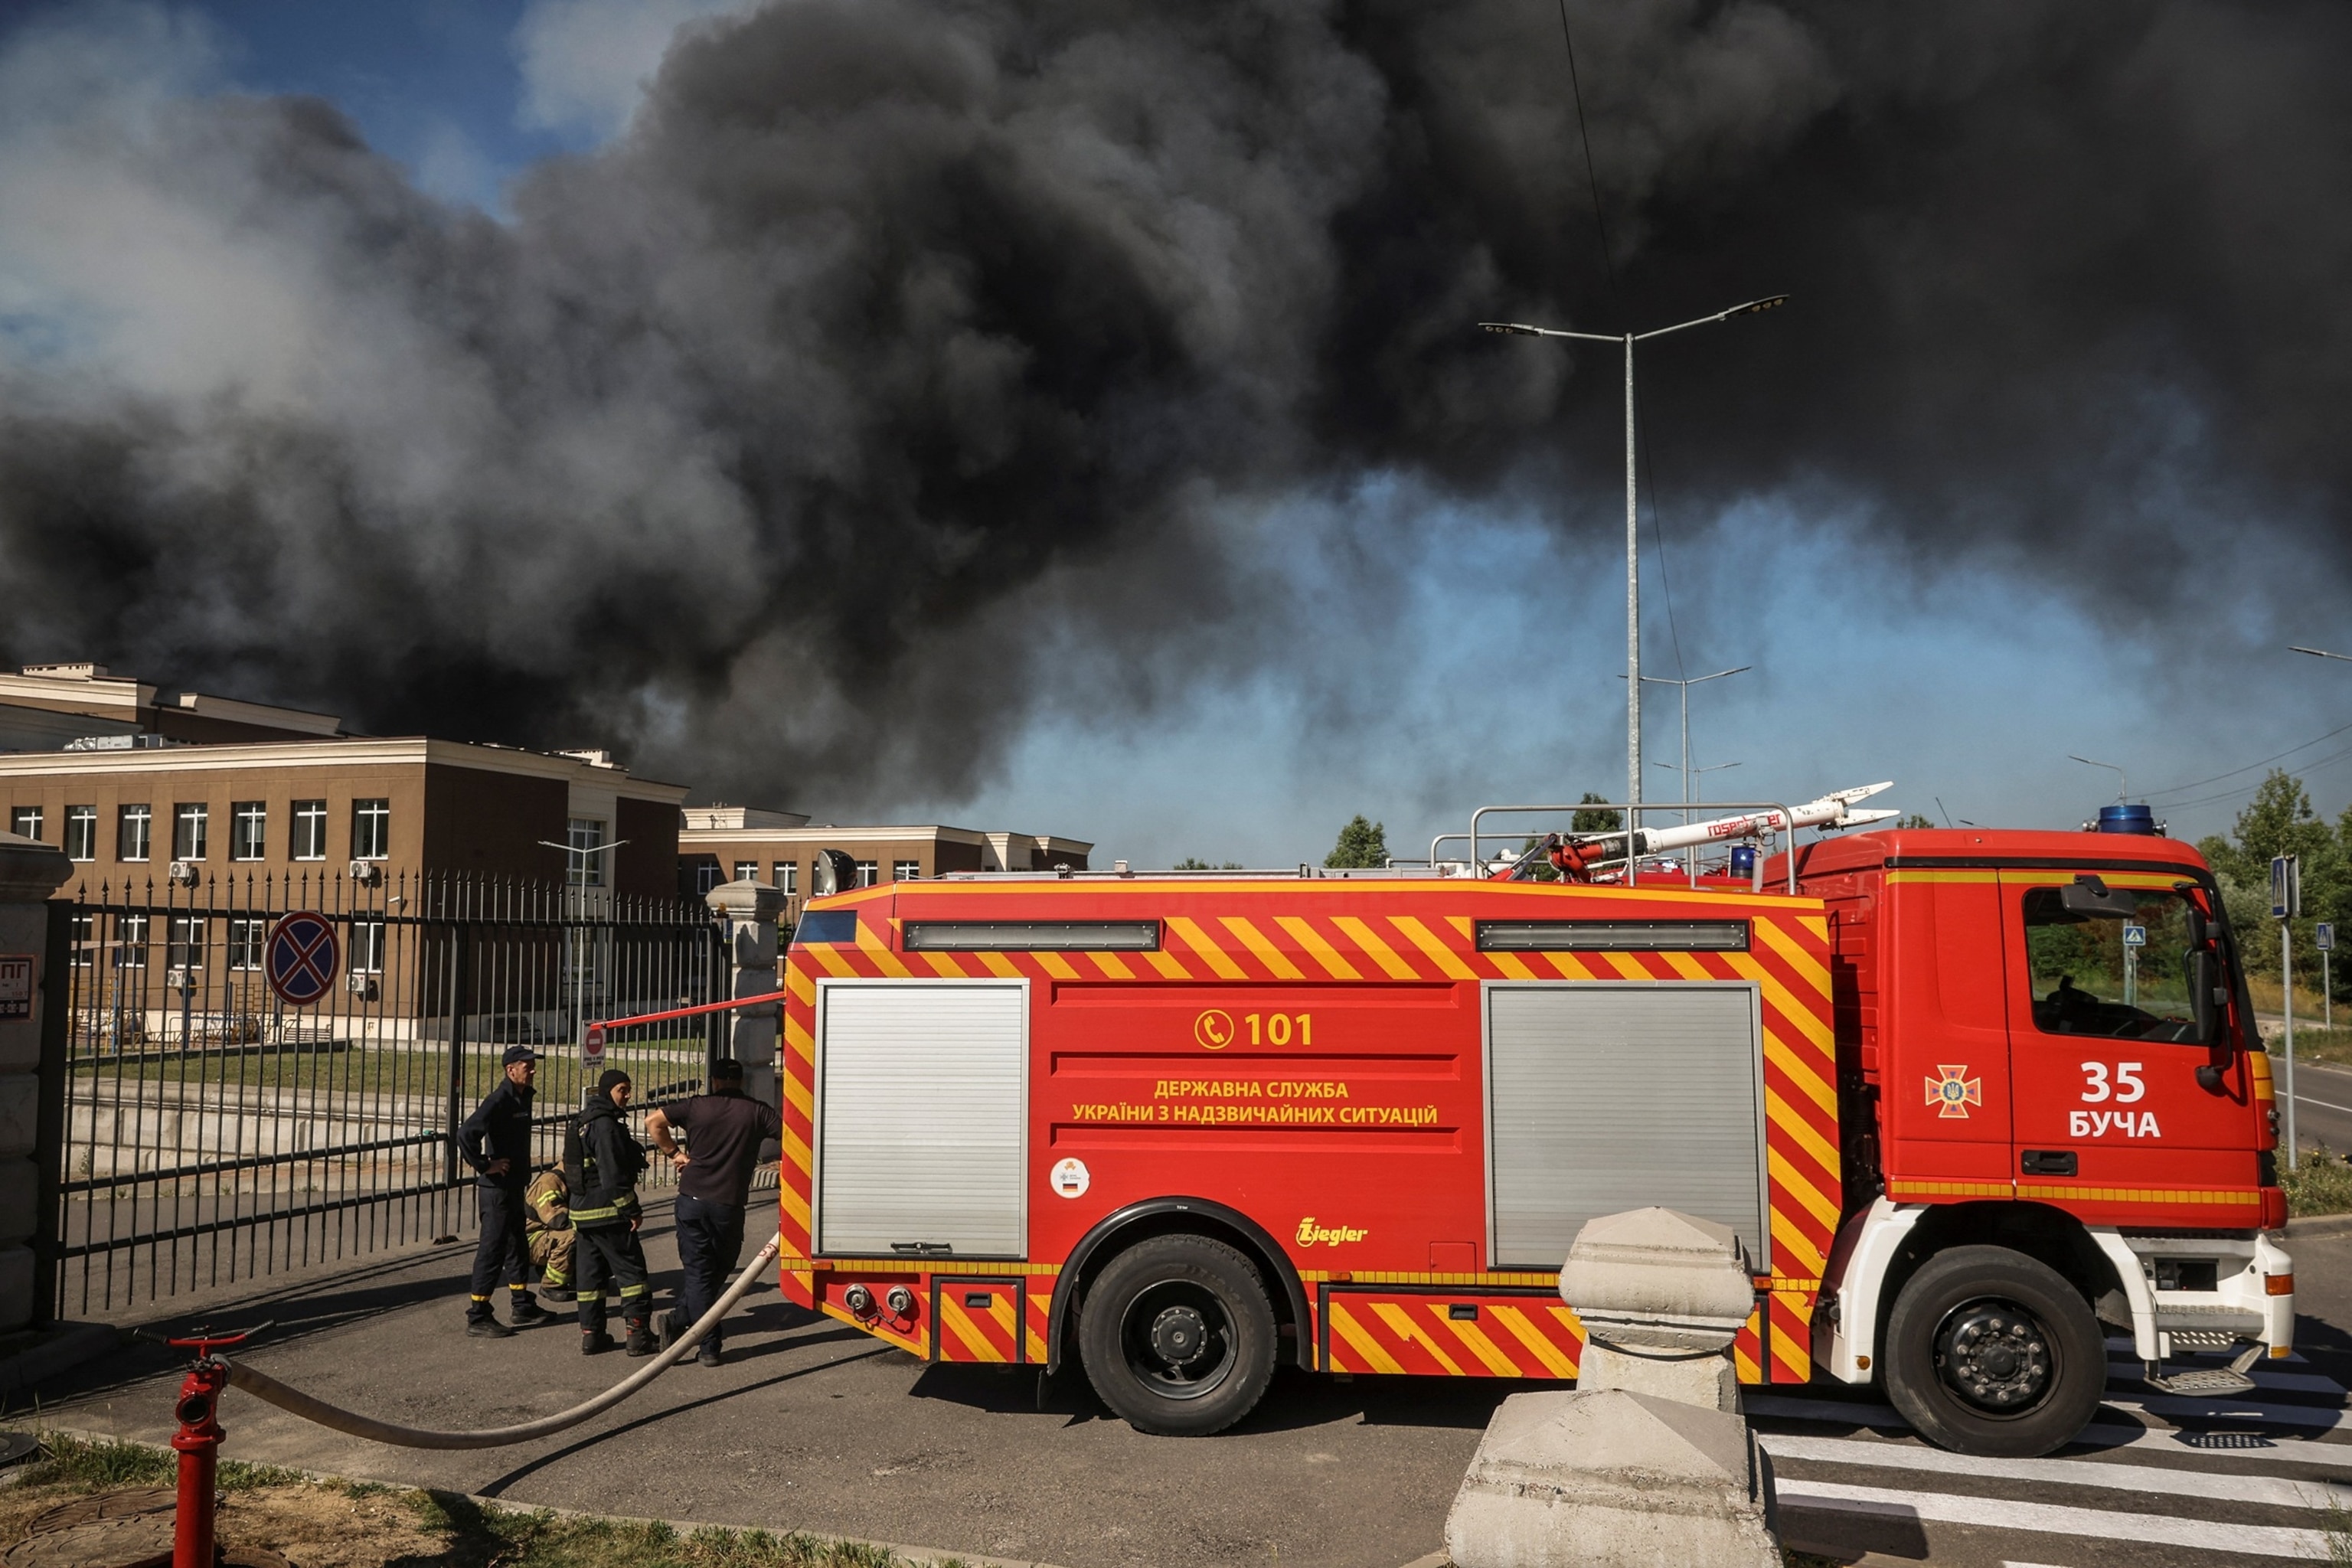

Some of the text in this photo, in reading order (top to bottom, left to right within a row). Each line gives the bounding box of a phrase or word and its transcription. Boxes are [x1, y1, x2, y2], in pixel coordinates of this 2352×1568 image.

[2, 963, 27, 979] ПГ
[1245, 1014, 1312, 1046] 101
[1155, 1080, 1348, 1099] ДЕРЖАВНА СЛУЖБА
[2080, 1061, 2145, 1103] 35
[1073, 1102, 1154, 1122] УКРАЇНИ
[1174, 1104, 1334, 1125] НАДЗВИЧАЙНИХ
[1339, 1105, 1438, 1127] СИТУАЦІЙ
[2069, 1111, 2161, 1138] БУЧА
[1296, 1217, 1368, 1247] Ziegler
